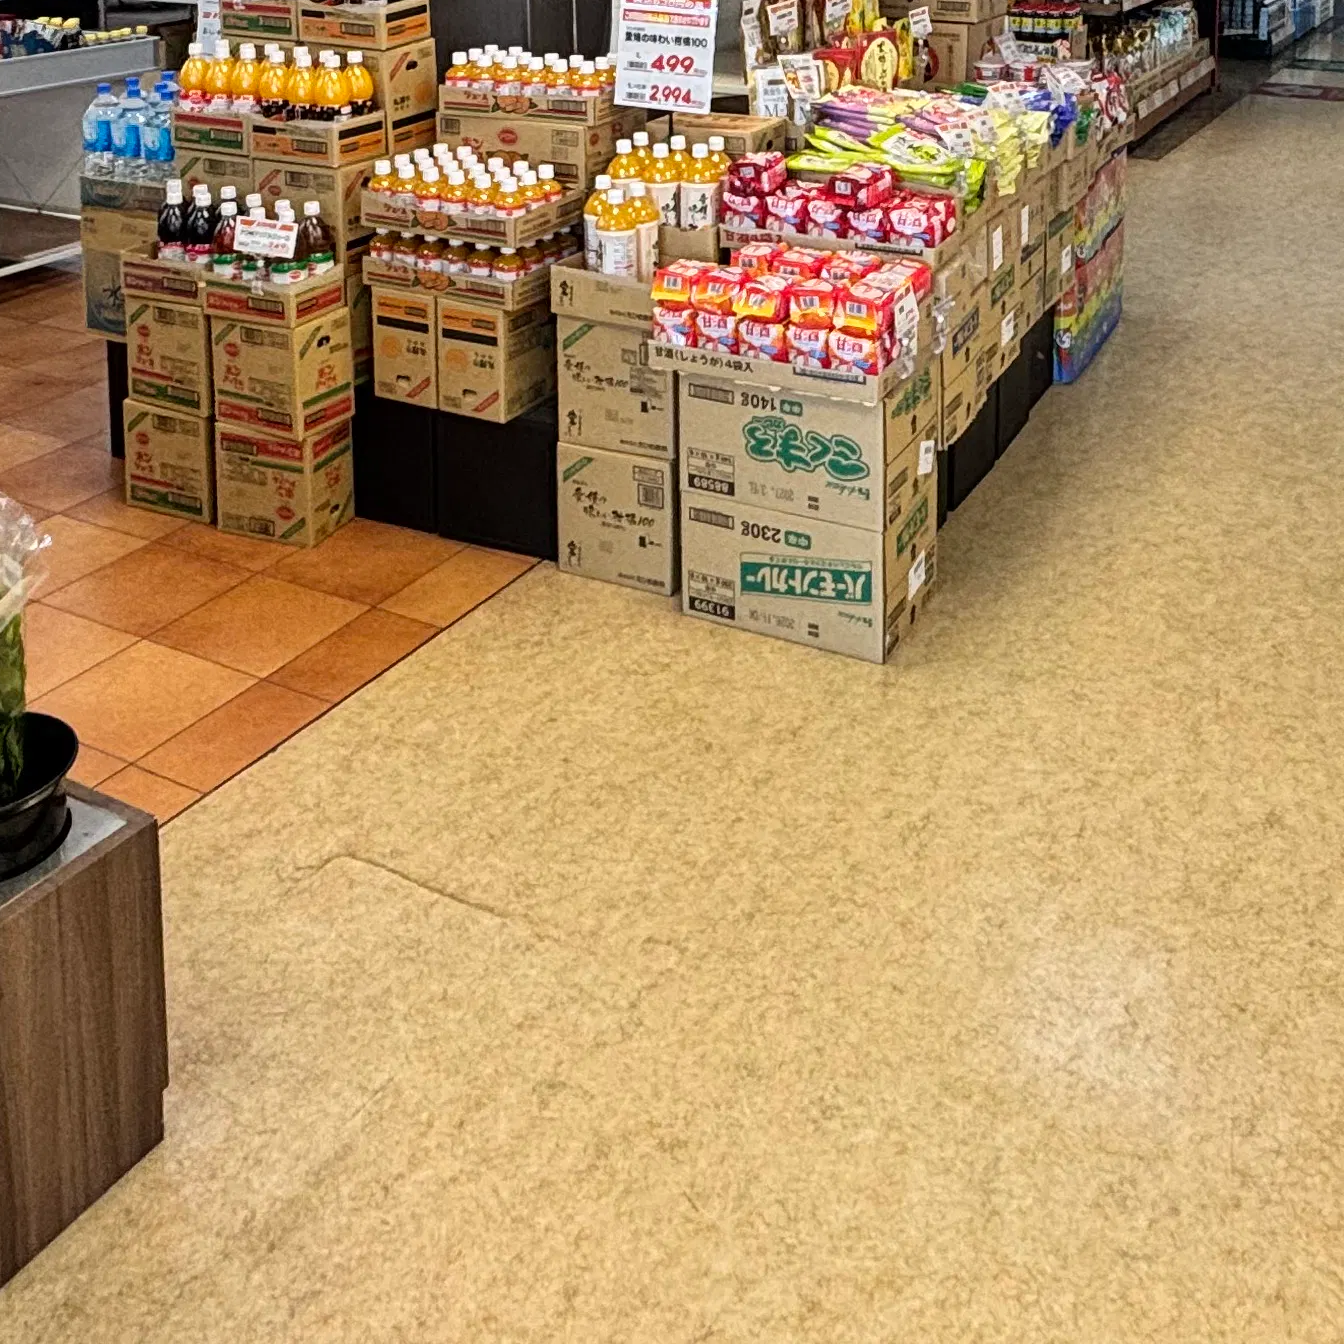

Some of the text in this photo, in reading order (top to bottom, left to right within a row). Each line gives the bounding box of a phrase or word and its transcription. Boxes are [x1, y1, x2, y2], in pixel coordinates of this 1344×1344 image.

[651, 54, 694, 73] 499
[702, 316, 728, 330] 甘酒
[745, 321, 770, 337] 甘酒
[837, 337, 864, 354] 甘酒
[655, 346, 755, 374] 甘酒(しょうが)4袋入
[740, 392, 776, 412] 140g
[693, 480, 729, 494] 88589
[740, 521, 782, 544] 230g
[744, 566, 867, 601] バーモントカレー
[694, 599, 730, 617] 91399
